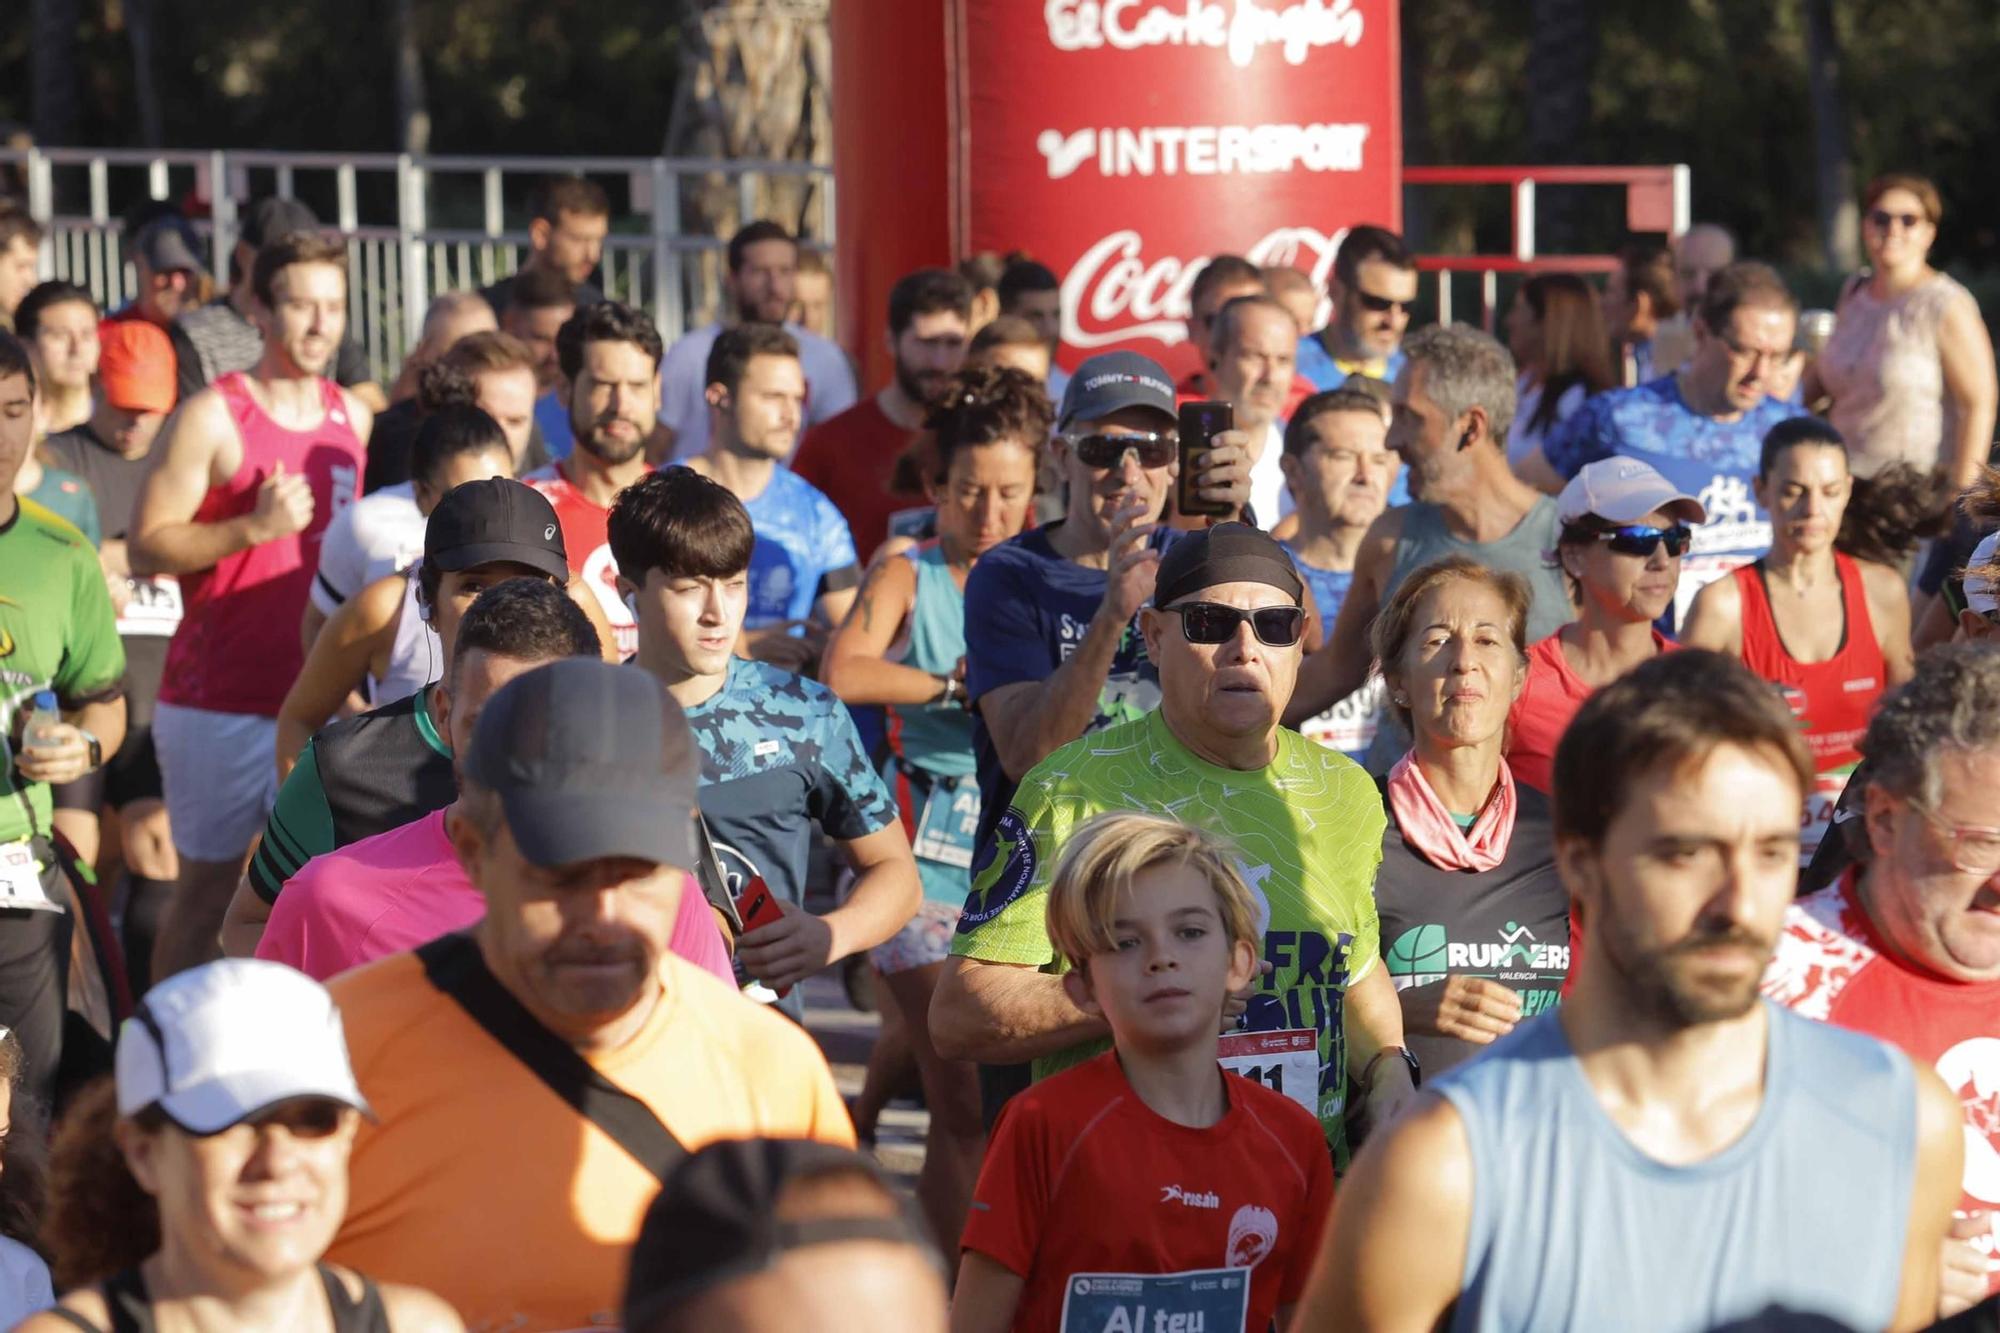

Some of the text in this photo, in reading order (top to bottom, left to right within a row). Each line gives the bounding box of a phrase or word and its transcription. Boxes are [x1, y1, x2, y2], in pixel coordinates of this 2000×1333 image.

[1103, 0, 1227, 50] Corte
[1099, 123, 1370, 177] INTERSPORT
[1263, 930, 1355, 990] FRE
